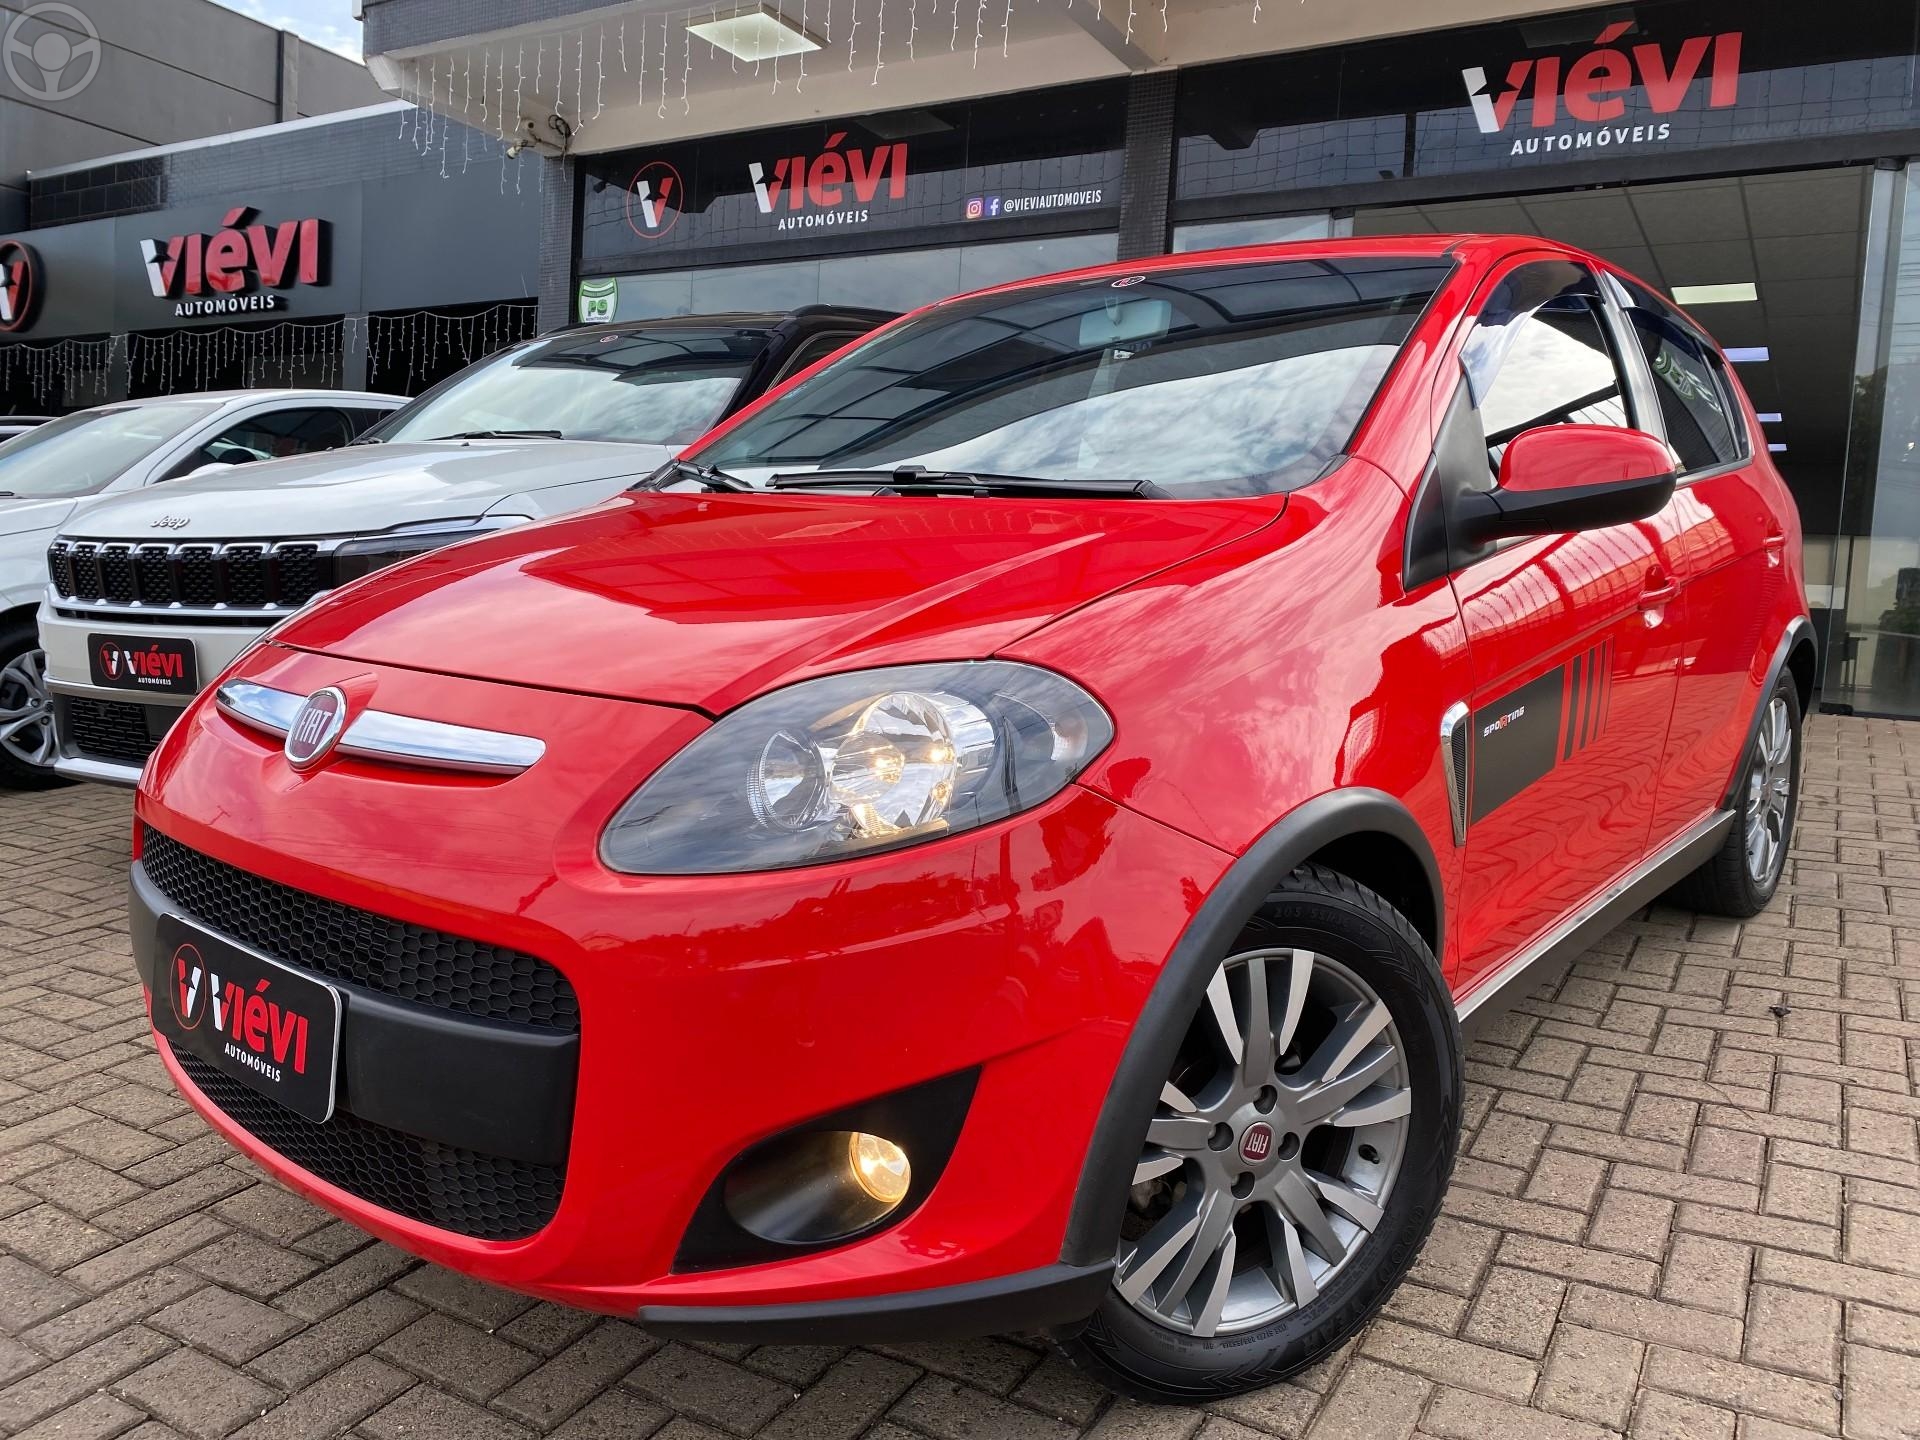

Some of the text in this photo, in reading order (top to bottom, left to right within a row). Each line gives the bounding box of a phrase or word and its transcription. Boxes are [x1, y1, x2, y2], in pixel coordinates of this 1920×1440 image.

[1510, 122, 1671, 156] AUTOMÓVEIS
[1003, 189, 1103, 212] @VIEVIAUTOMOVEIS
[778, 209, 869, 231] AUTOMÓVEIS
[174, 293, 275, 317] AUTOMÓVEIS
[150, 514, 191, 530] Jeep
[137, 676, 172, 686] AUTOMÓVEIS
[294, 707, 334, 745] FIAT
[1483, 705, 1525, 738] SPORTING
[224, 1042, 282, 1083] AUTOMÓVEIS
[1245, 1132, 1269, 1154] FIAT
